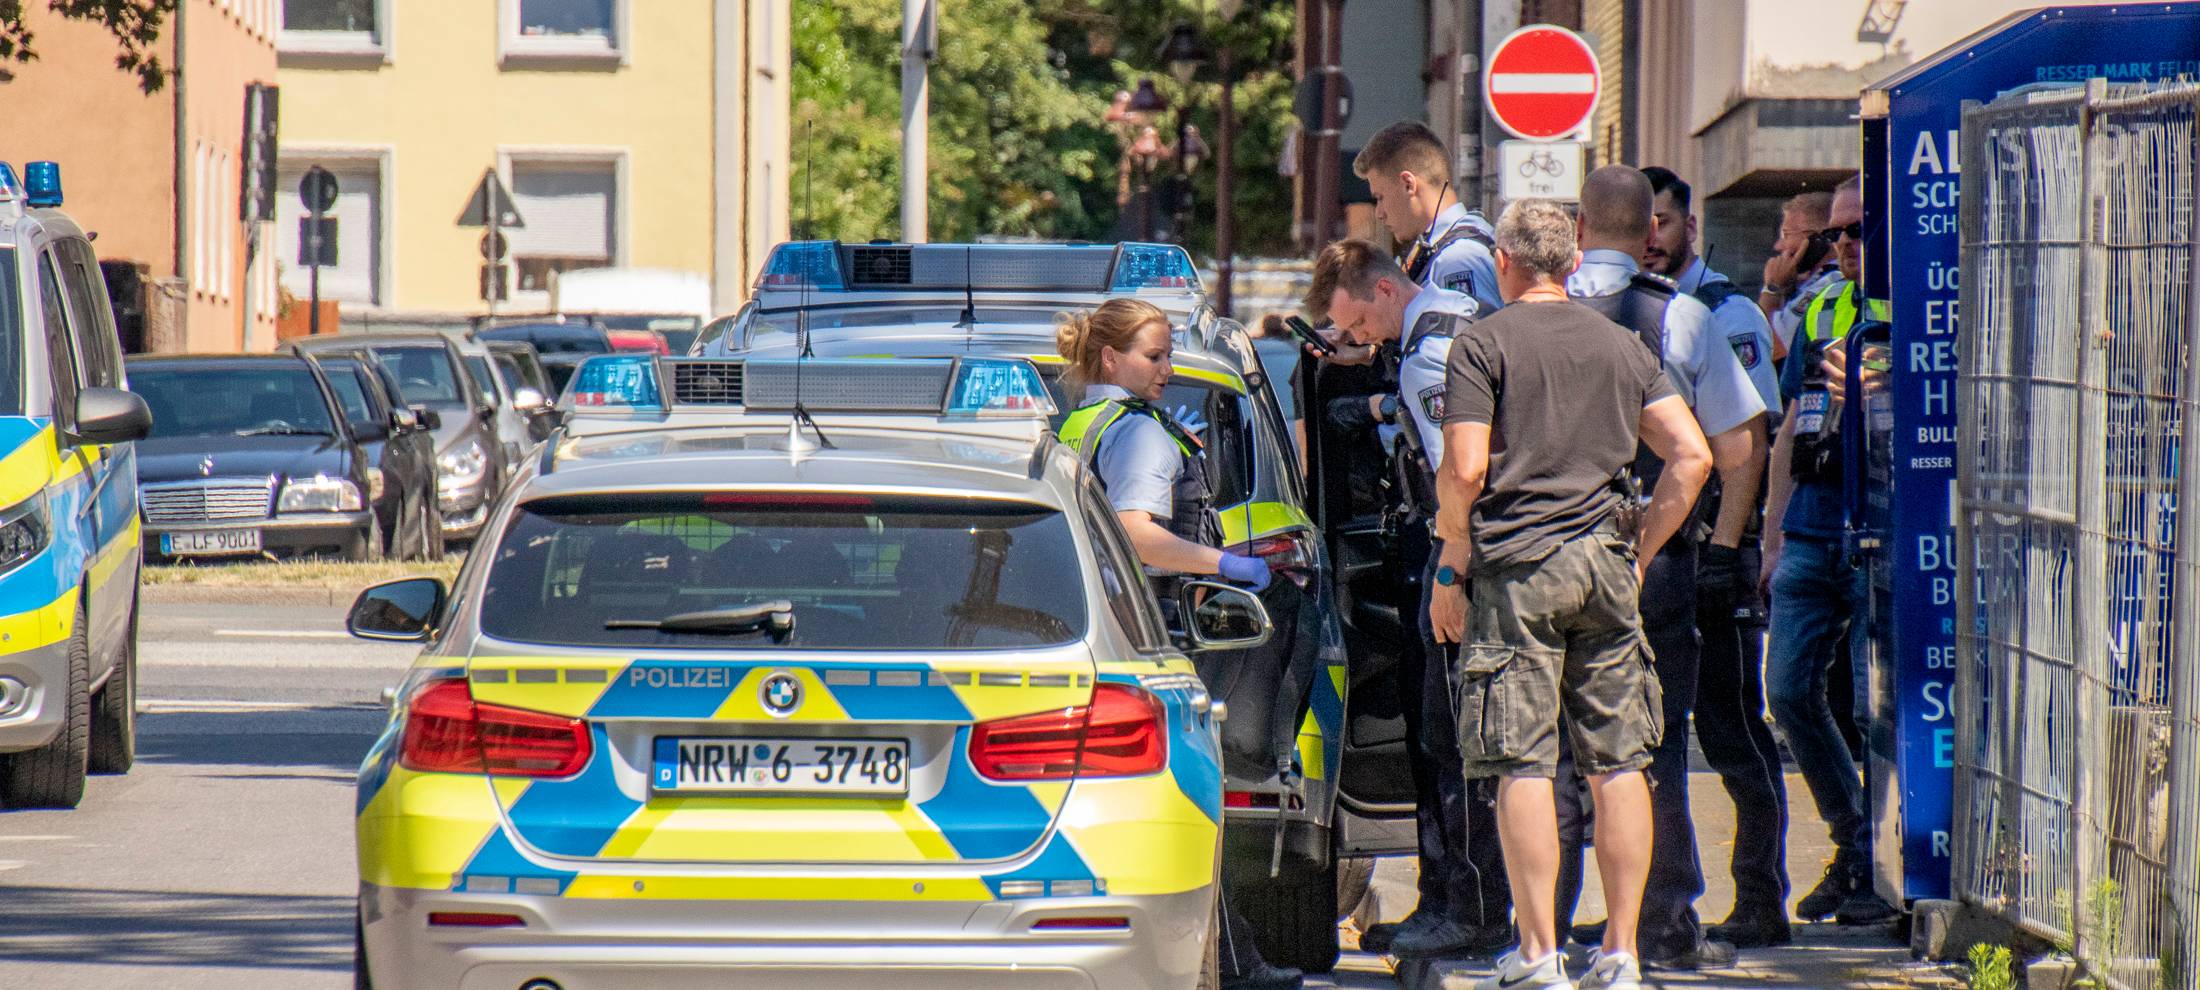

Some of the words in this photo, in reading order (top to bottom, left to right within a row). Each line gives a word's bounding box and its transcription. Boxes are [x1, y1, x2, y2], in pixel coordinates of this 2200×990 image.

[2036, 64, 2097, 81] RESSER
[2104, 62, 2152, 78] MARK
[2159, 61, 2200, 77] FELD
[1908, 129, 1961, 175] AL
[1913, 181, 1961, 209] SCH
[1918, 214, 1957, 235] SCH
[1928, 261, 1960, 290] ÜC
[1926, 301, 1960, 335] ER
[1917, 427, 1958, 443] BUL
[1911, 457, 1952, 469] RESSER
[630, 668, 730, 688] POLIZEI
[661, 768, 672, 781] D
[679, 744, 749, 783] NRW
[772, 744, 902, 784] 6-3748
